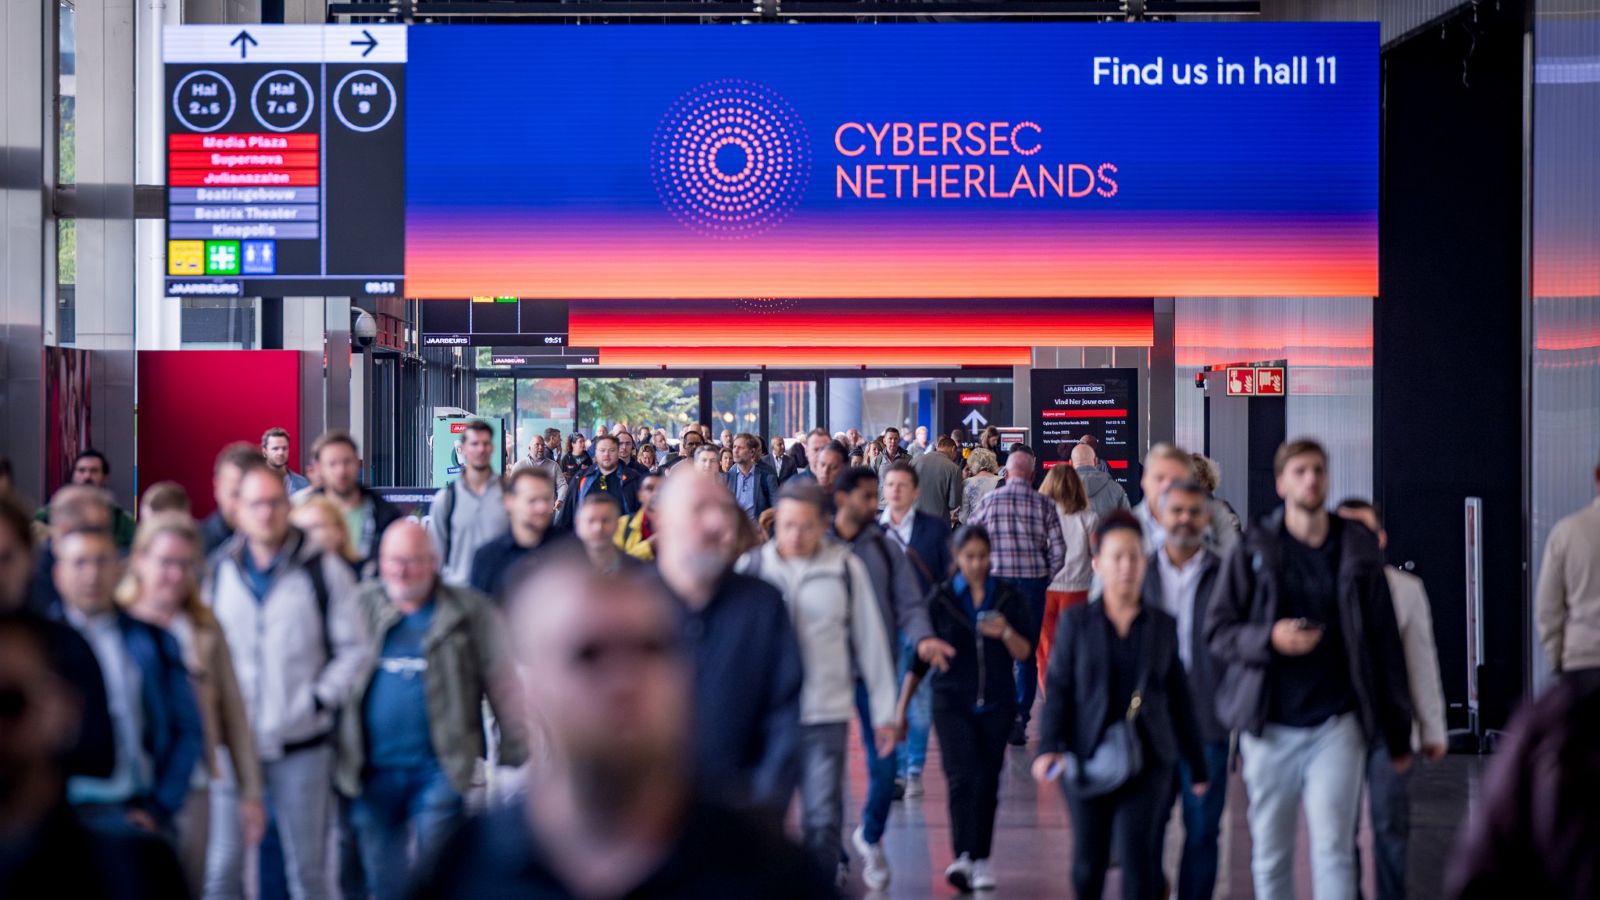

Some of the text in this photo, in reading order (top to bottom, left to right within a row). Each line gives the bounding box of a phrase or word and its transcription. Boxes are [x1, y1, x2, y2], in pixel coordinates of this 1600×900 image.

[1093, 56, 1337, 85] Find us in hall 11
[192, 84, 217, 96] Hal
[269, 83, 295, 95] Hal
[352, 83, 377, 95] Hal
[358, 101, 371, 114] 9
[203, 136, 287, 148] Media Plaza
[834, 121, 1042, 157] CYBERSEC
[211, 153, 283, 167] Supernova
[835, 163, 1120, 199] NETHERLANDS
[246, 207, 297, 219] Theater
[212, 224, 276, 238] Kinepolis
